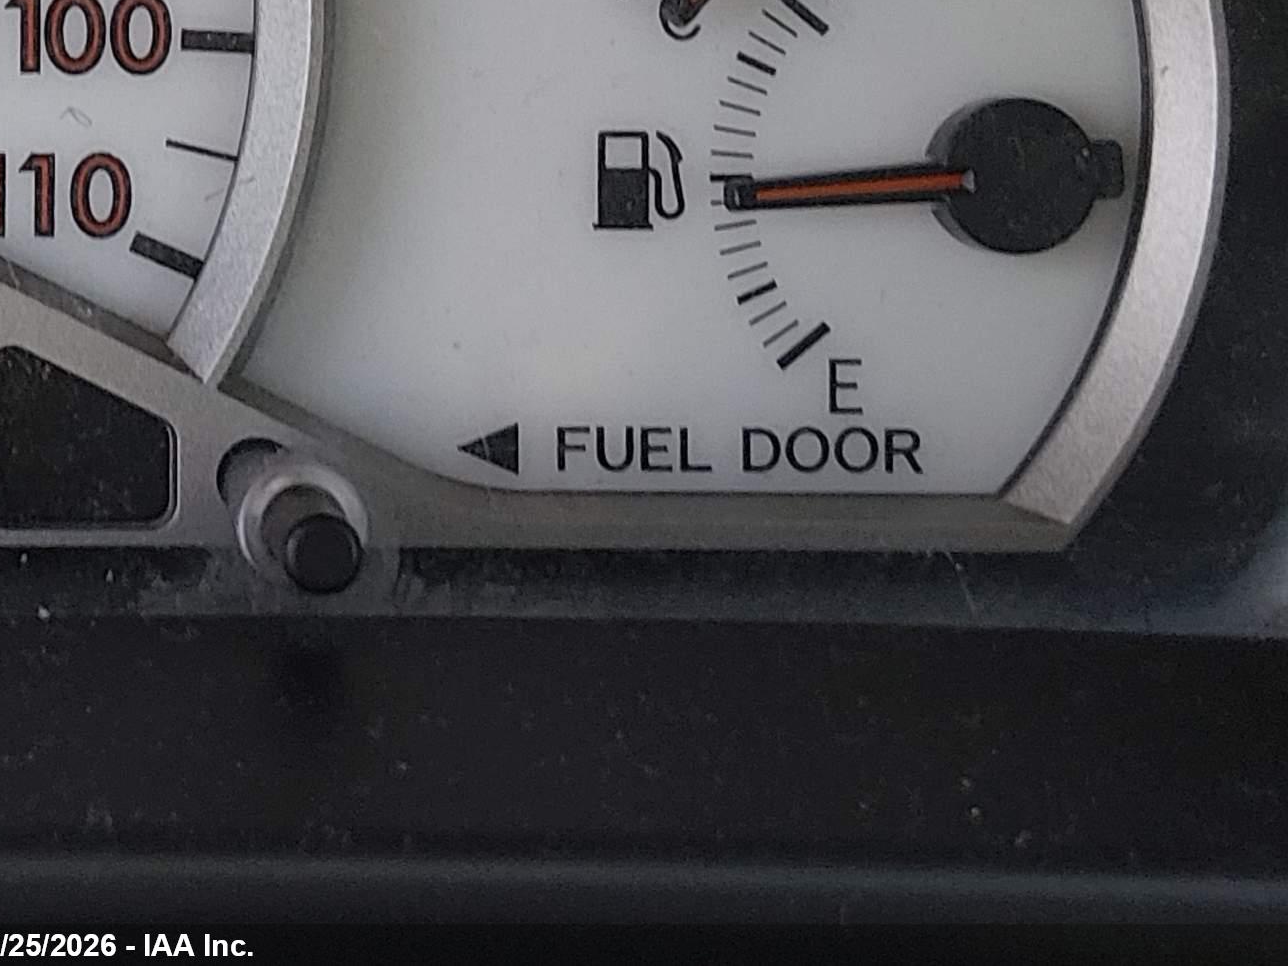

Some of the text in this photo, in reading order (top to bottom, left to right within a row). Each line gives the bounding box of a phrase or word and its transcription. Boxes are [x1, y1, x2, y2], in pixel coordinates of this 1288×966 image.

[829, 359, 863, 414] E
[557, 427, 923, 474] FUEL DOOR
